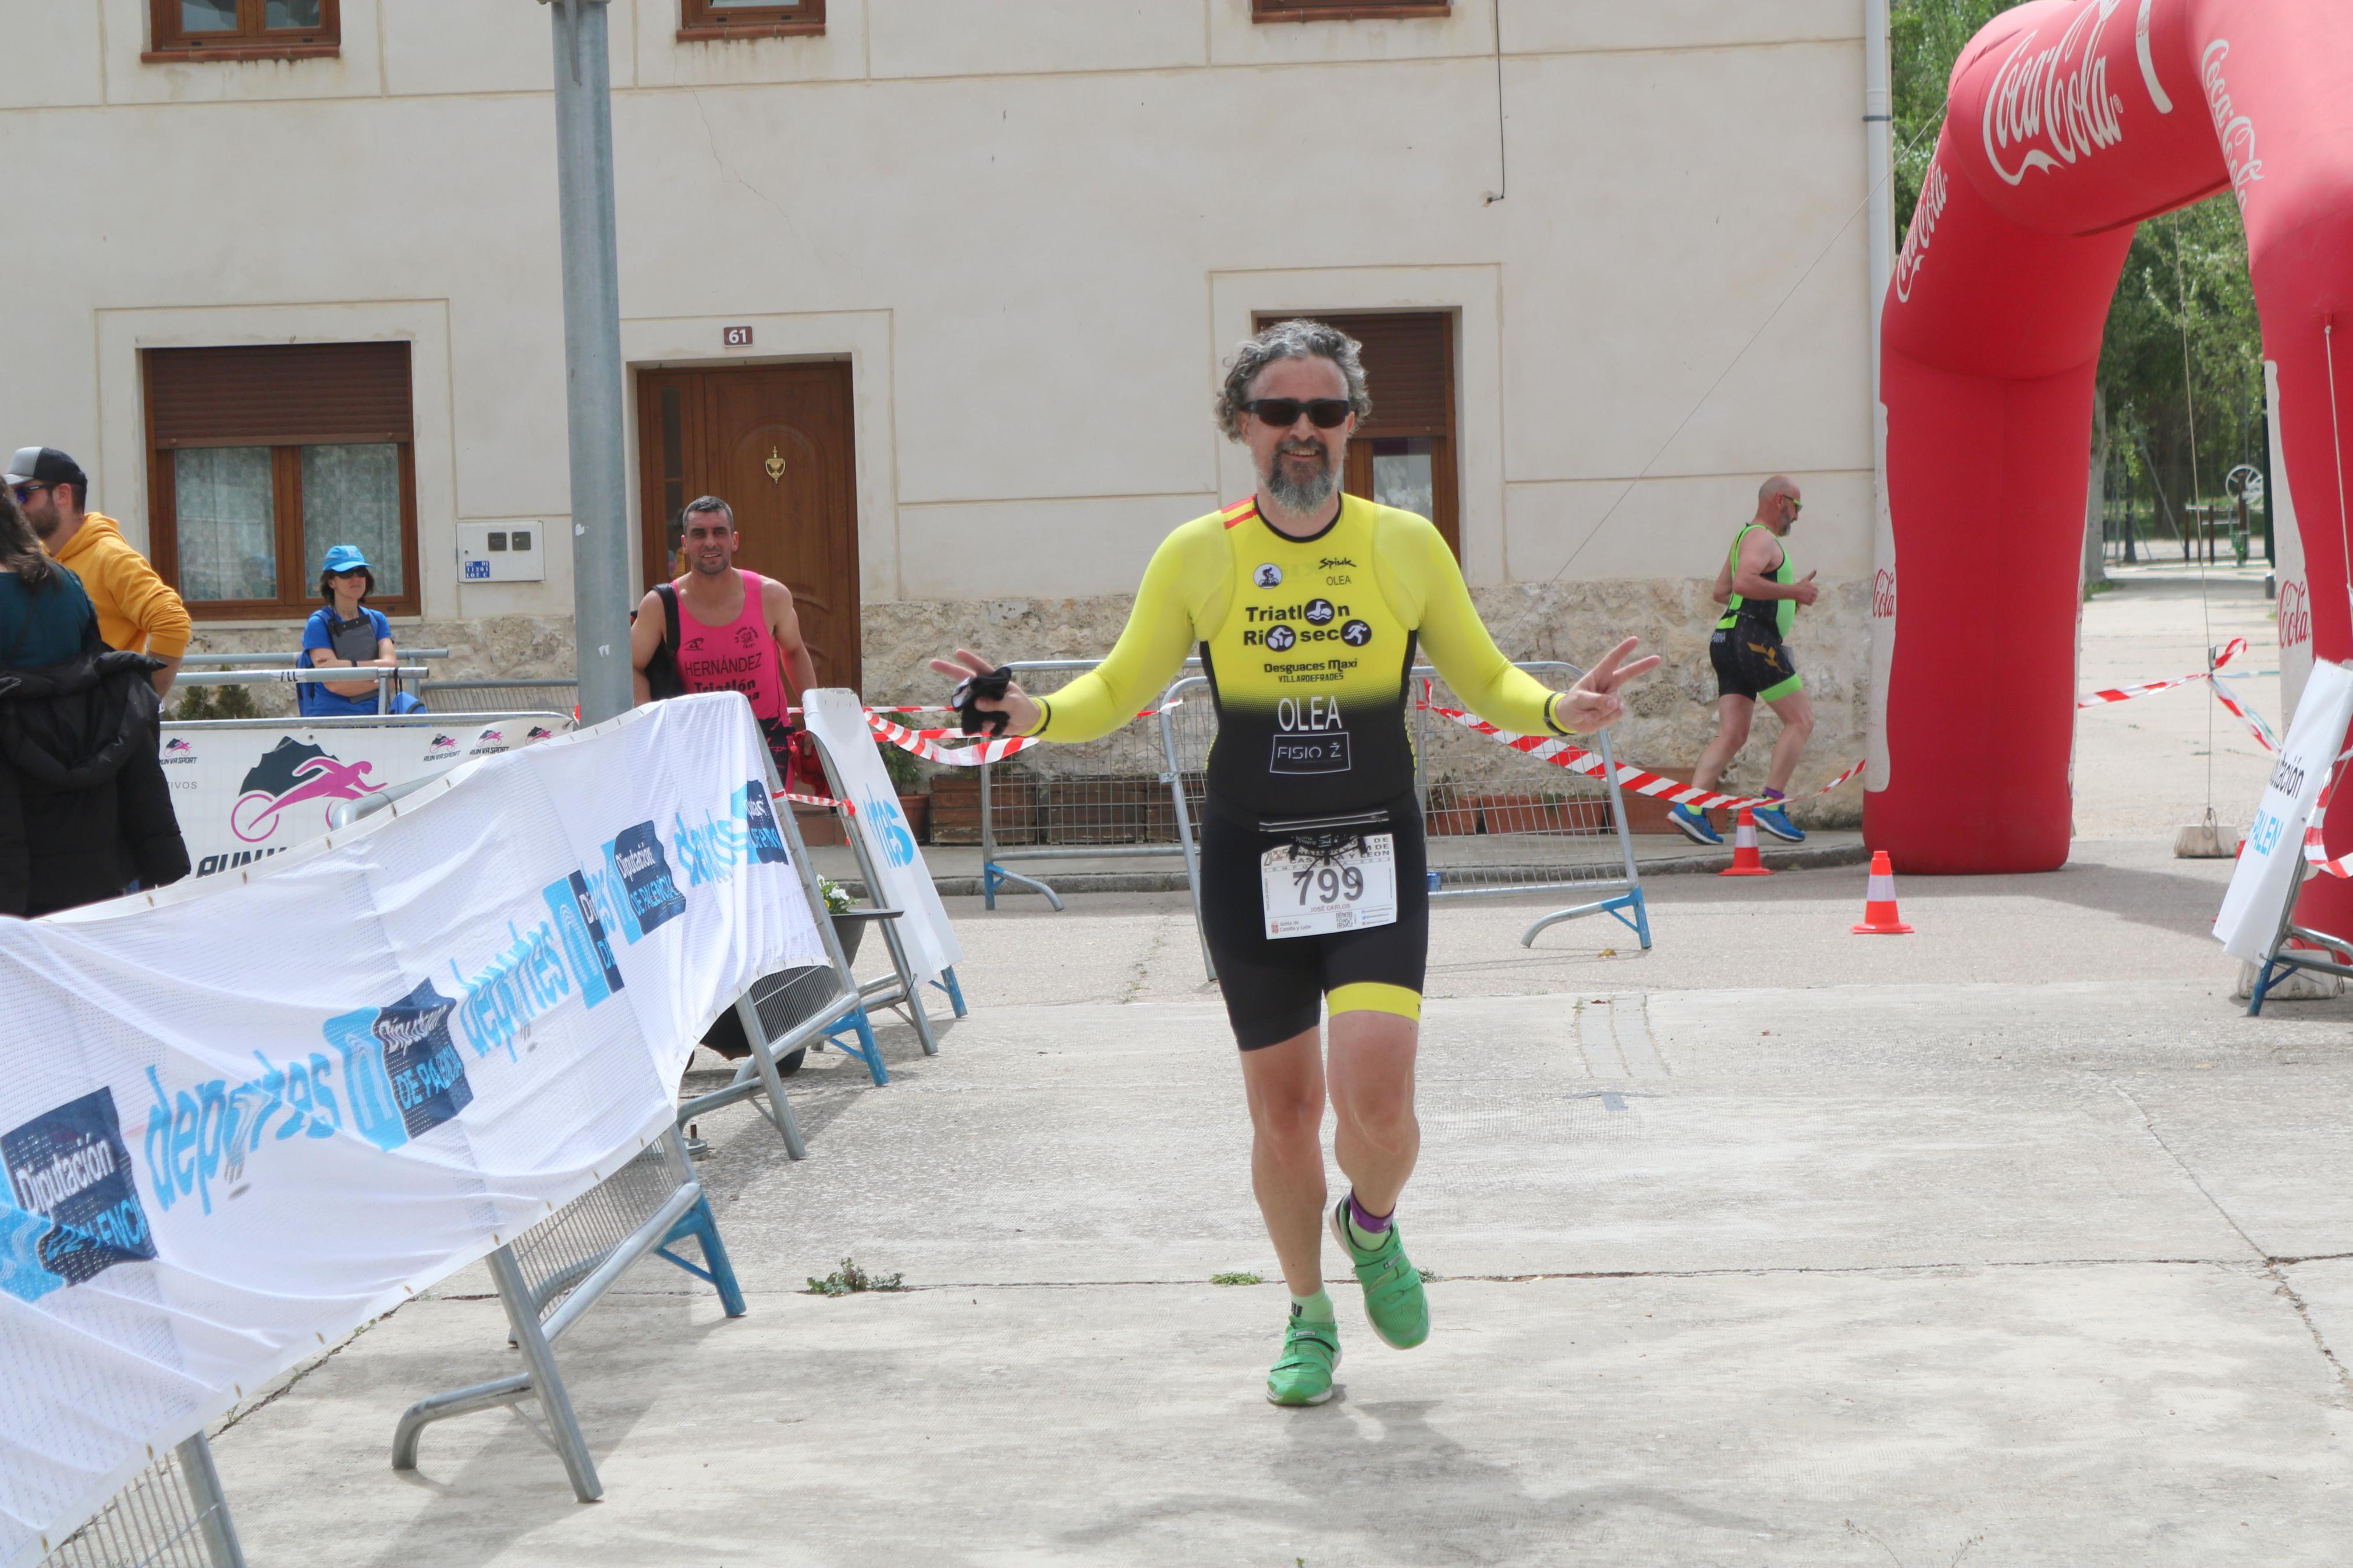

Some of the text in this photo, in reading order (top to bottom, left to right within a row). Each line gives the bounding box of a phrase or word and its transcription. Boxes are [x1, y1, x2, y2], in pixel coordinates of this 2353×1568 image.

[729, 329, 746, 343] 61
[1318, 557, 1357, 570] Spiuk
[1326, 575, 1351, 586] OLEA
[684, 652, 762, 677] HERNÁNDEZ
[1264, 659, 1358, 674] Desguaces Maxi
[1278, 673, 1344, 683] VILLARDEFRADES
[1278, 696, 1343, 732] OLEA
[443, 750, 462, 759] SPORT
[1277, 747, 1322, 759] FISIO
[1292, 866, 1364, 906] 799
[15, 1132, 116, 1222] Diputación
